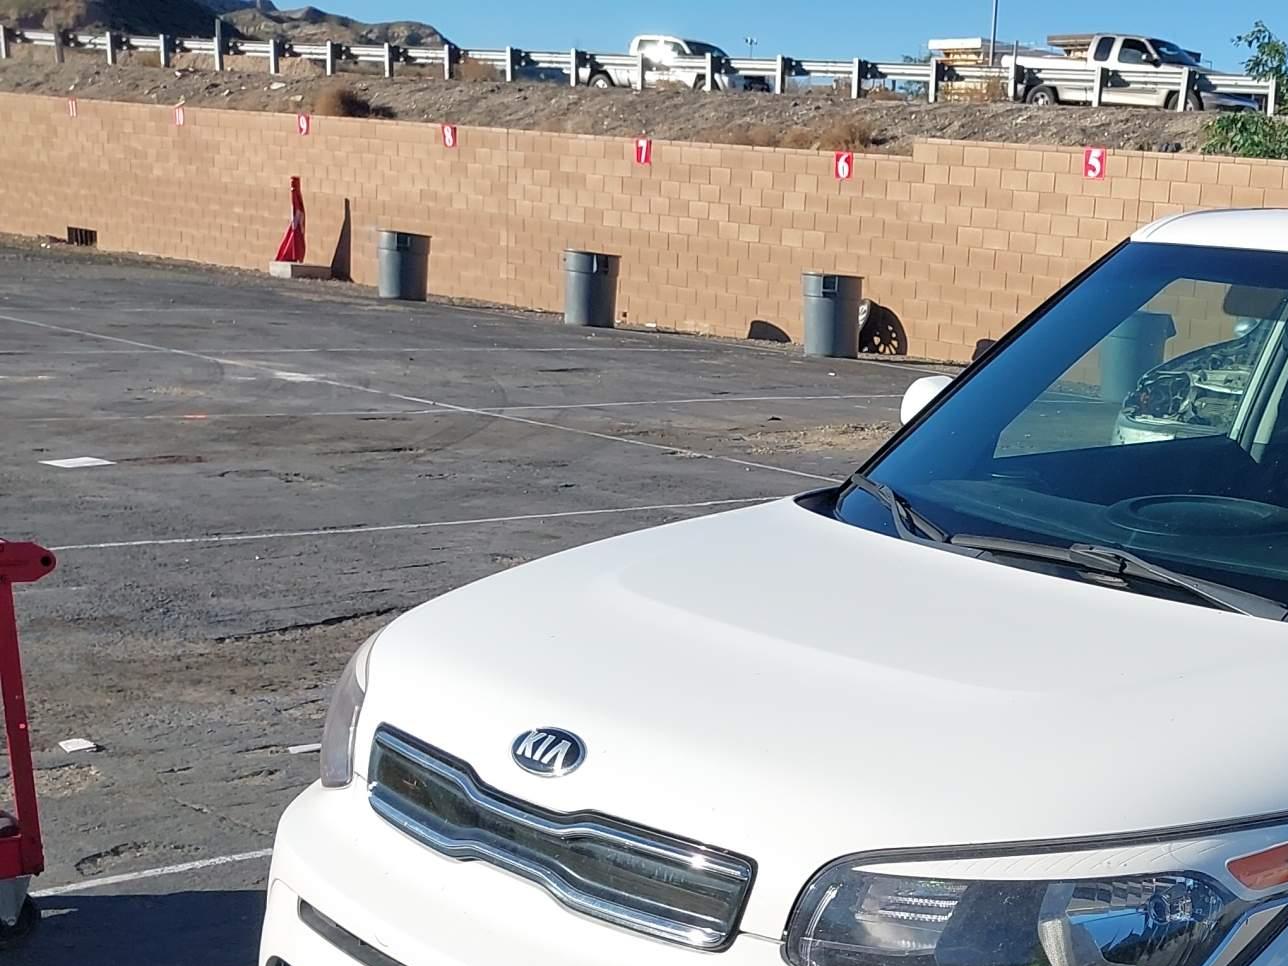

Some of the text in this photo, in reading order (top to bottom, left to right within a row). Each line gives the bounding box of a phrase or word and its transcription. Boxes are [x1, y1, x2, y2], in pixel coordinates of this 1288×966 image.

[68, 99, 77, 117] 11
[175, 107, 184, 126] 10
[298, 115, 307, 135] 9
[443, 125, 454, 147] 8
[637, 139, 648, 164] 7
[837, 151, 850, 179] 6
[1087, 149, 1103, 178] 5
[516, 730, 572, 771] KIA
